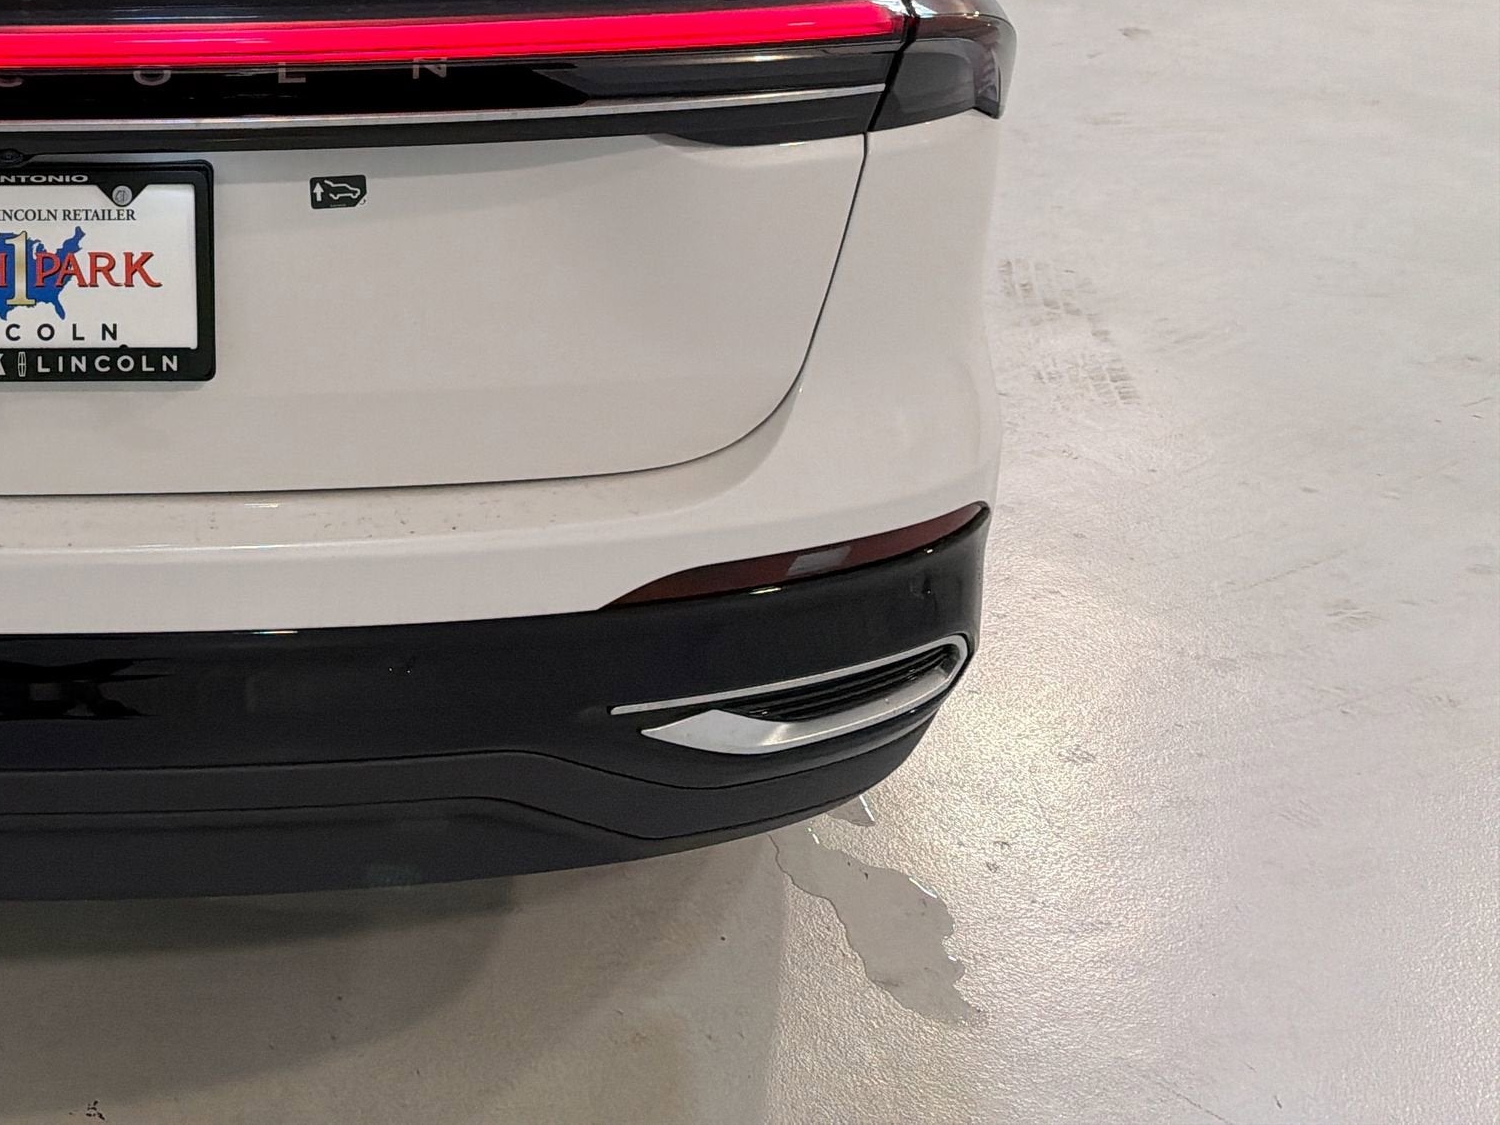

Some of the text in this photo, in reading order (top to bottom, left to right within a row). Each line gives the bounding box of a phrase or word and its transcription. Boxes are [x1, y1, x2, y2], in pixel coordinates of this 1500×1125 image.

[62, 208, 137, 221] RETAILER
[34, 251, 163, 288] PARK
[37, 355, 178, 373] LINCOLN
